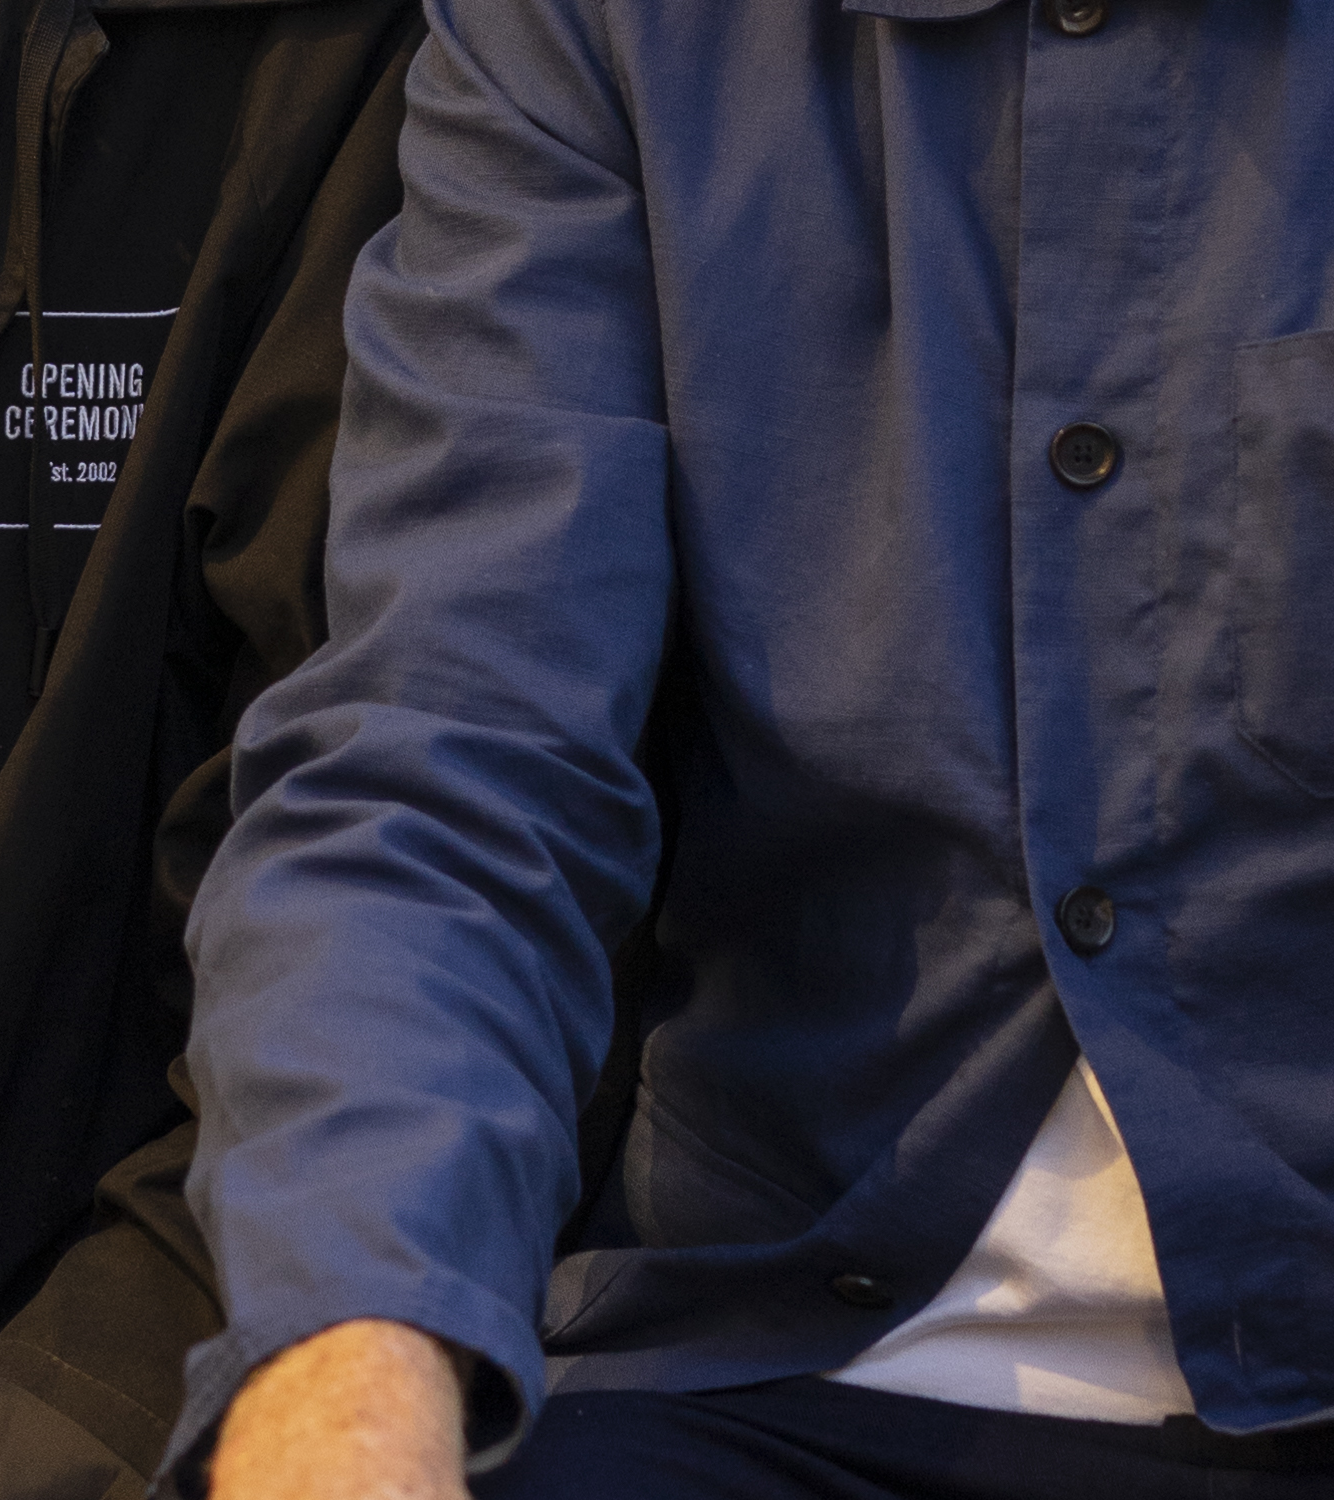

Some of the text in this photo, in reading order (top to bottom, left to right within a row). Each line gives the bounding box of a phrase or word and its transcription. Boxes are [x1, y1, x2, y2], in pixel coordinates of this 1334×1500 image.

[21, 362, 144, 399] OPENING
[49, 461, 117, 482] st. 2002
